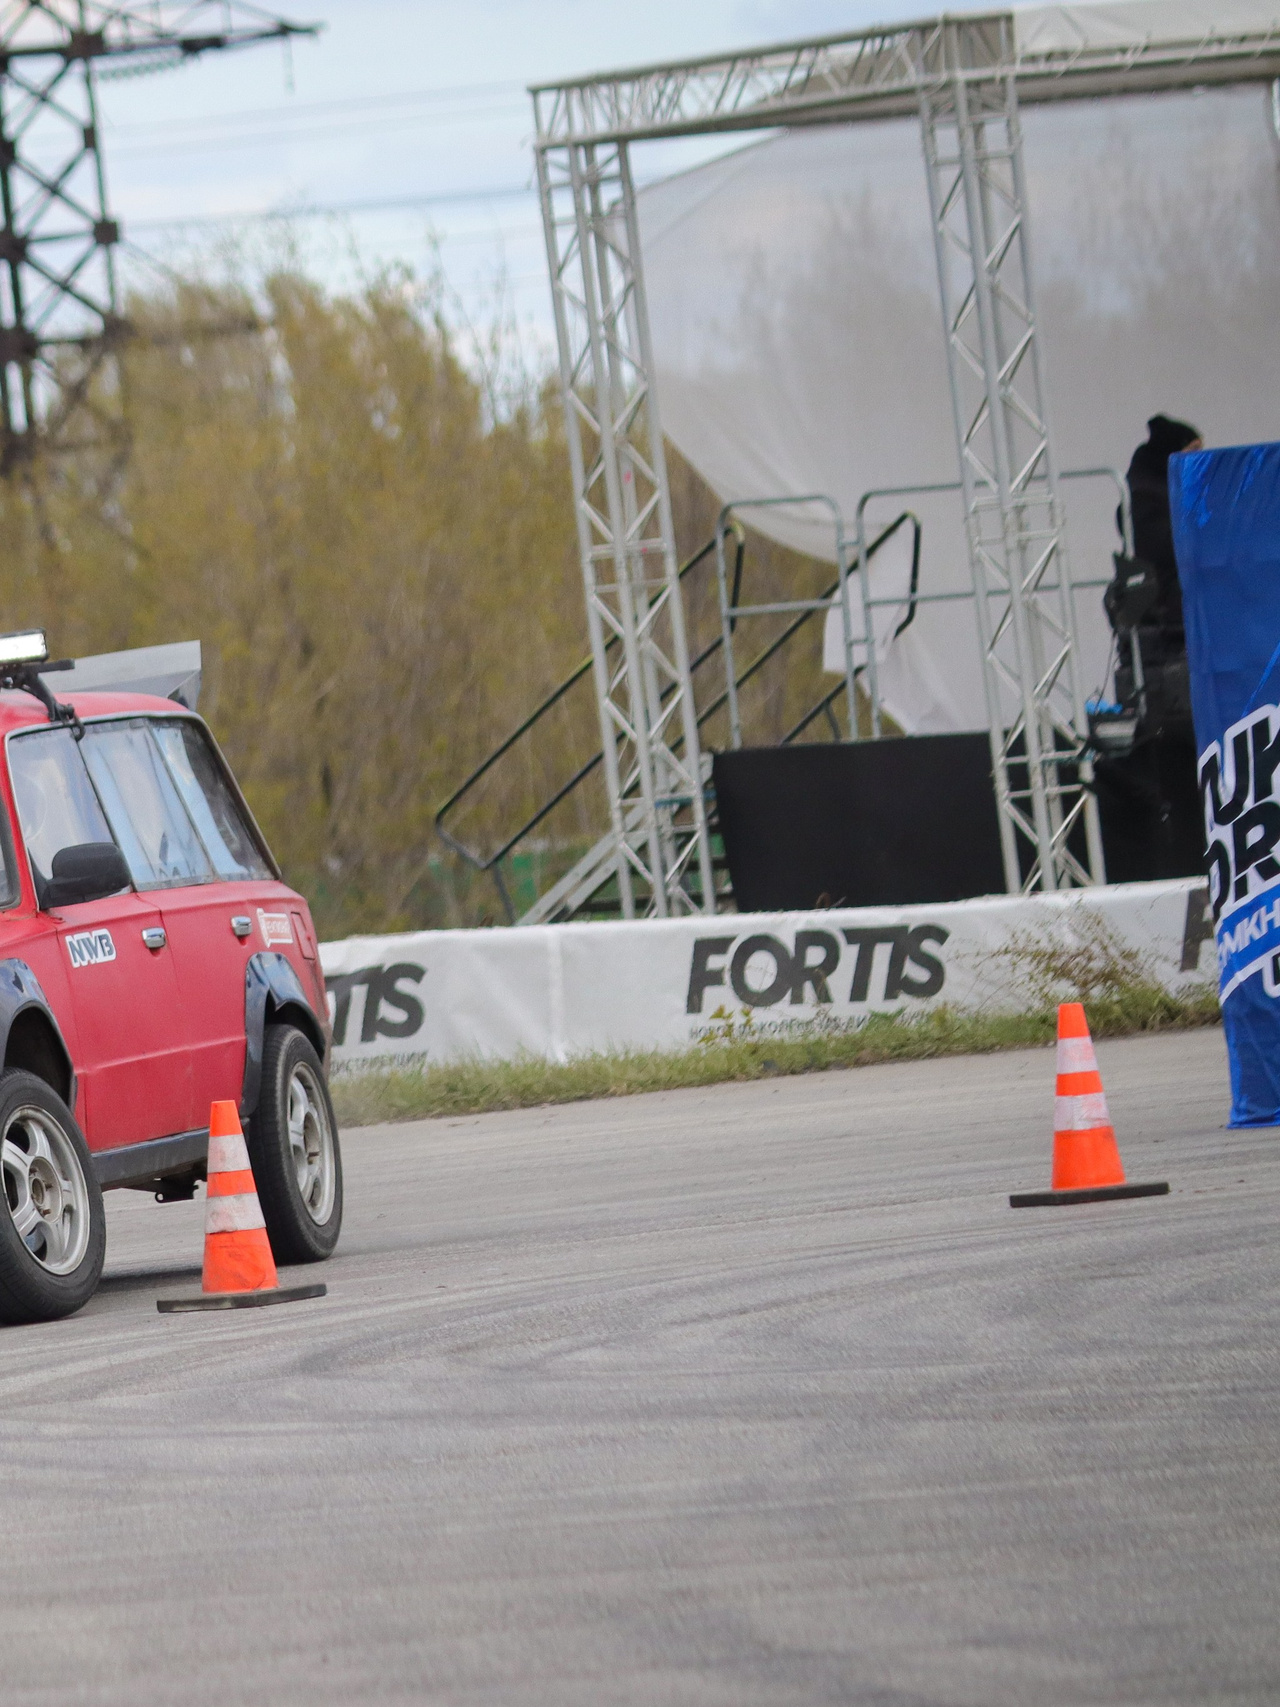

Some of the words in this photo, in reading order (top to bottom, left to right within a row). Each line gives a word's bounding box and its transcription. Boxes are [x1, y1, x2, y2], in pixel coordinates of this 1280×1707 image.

[68, 934, 114, 965] NWB
[686, 923, 951, 1014] FORTIS
[324, 962, 427, 1046] TIS
